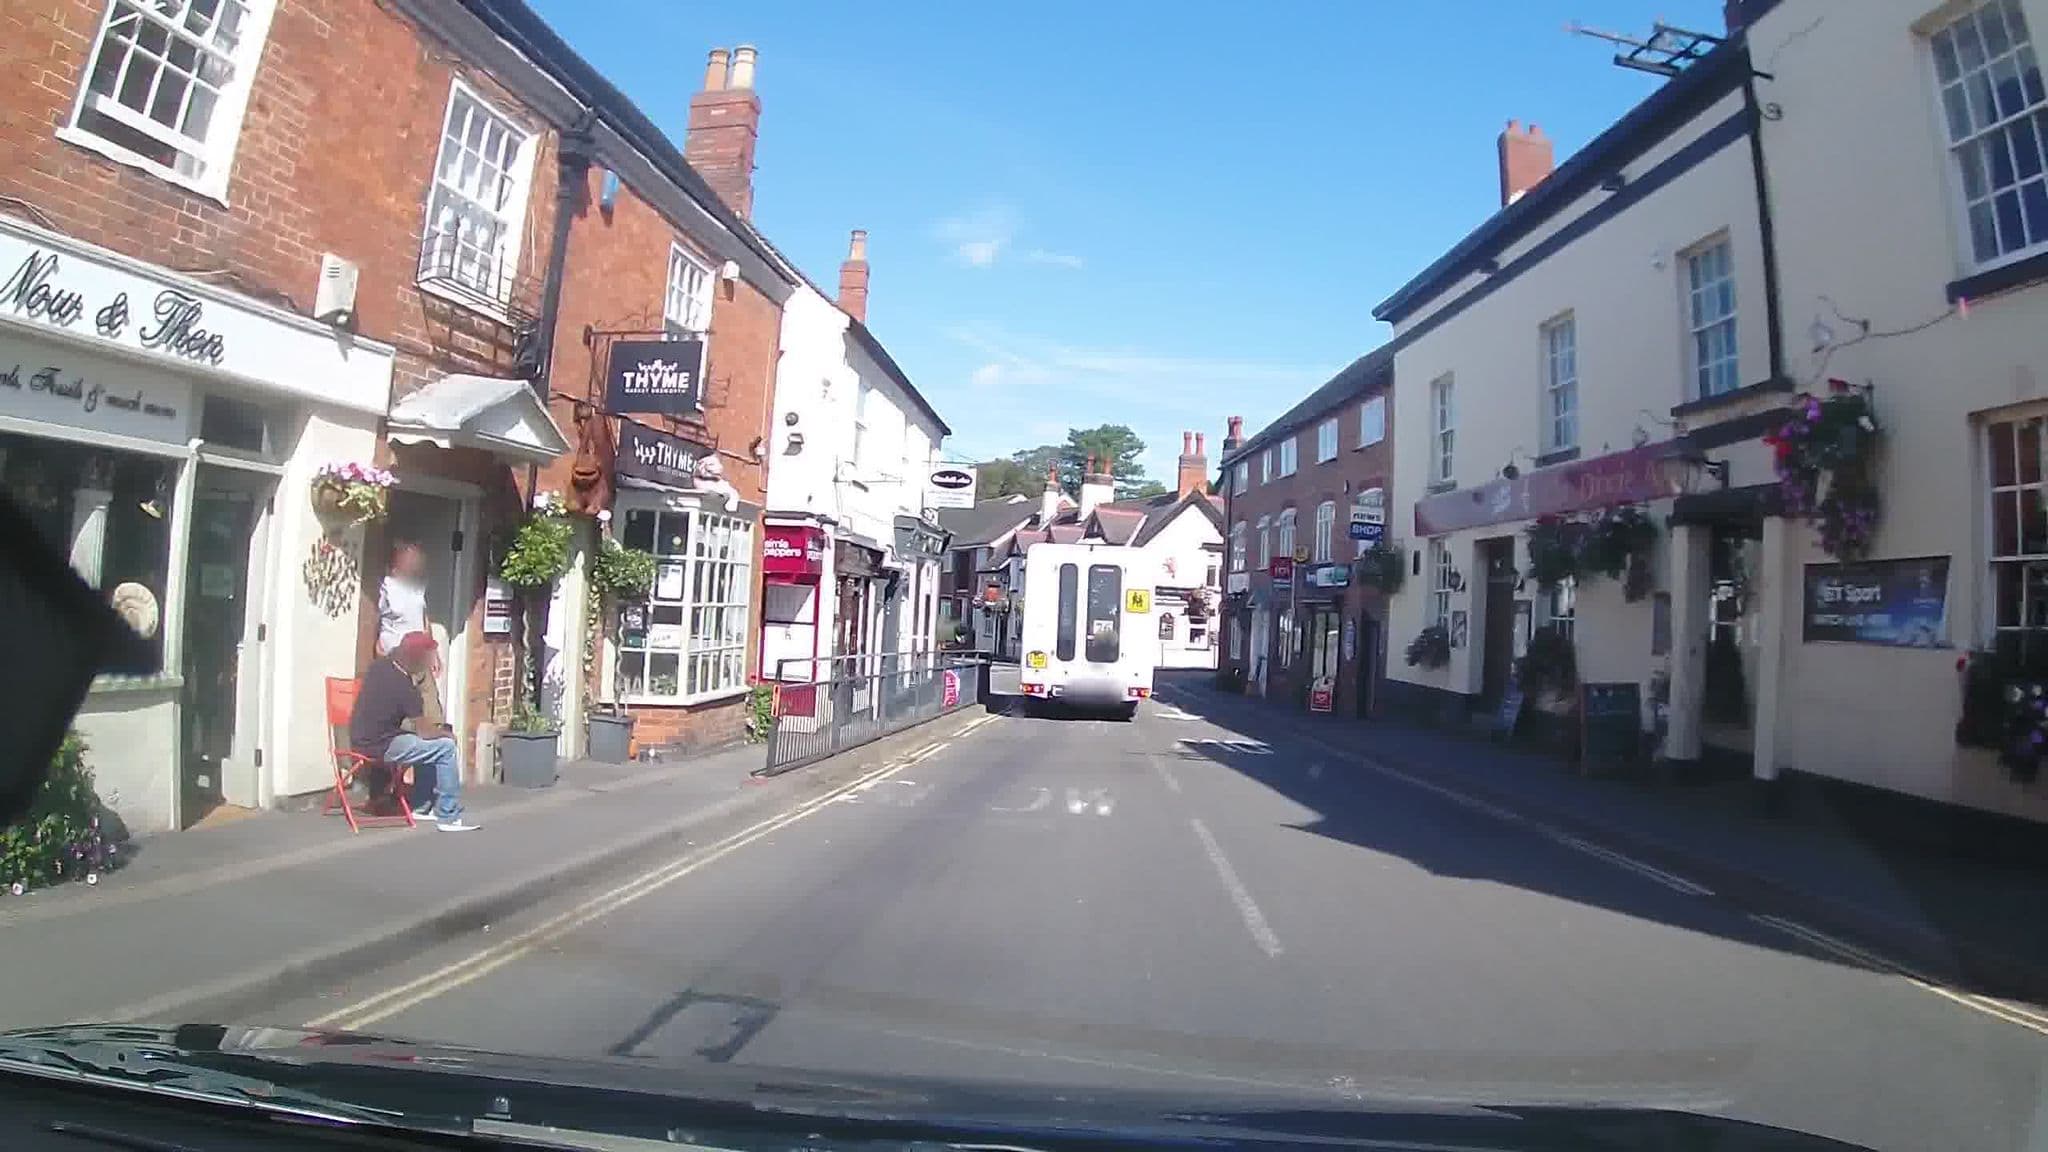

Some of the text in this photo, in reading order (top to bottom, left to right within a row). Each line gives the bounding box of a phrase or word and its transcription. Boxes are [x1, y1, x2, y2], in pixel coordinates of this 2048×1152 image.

[0, 250, 225, 362] Now & Then
[622, 372, 690, 388] THYME
[657, 442, 693, 472] THYME
[1352, 524, 1382, 534] SHOP
